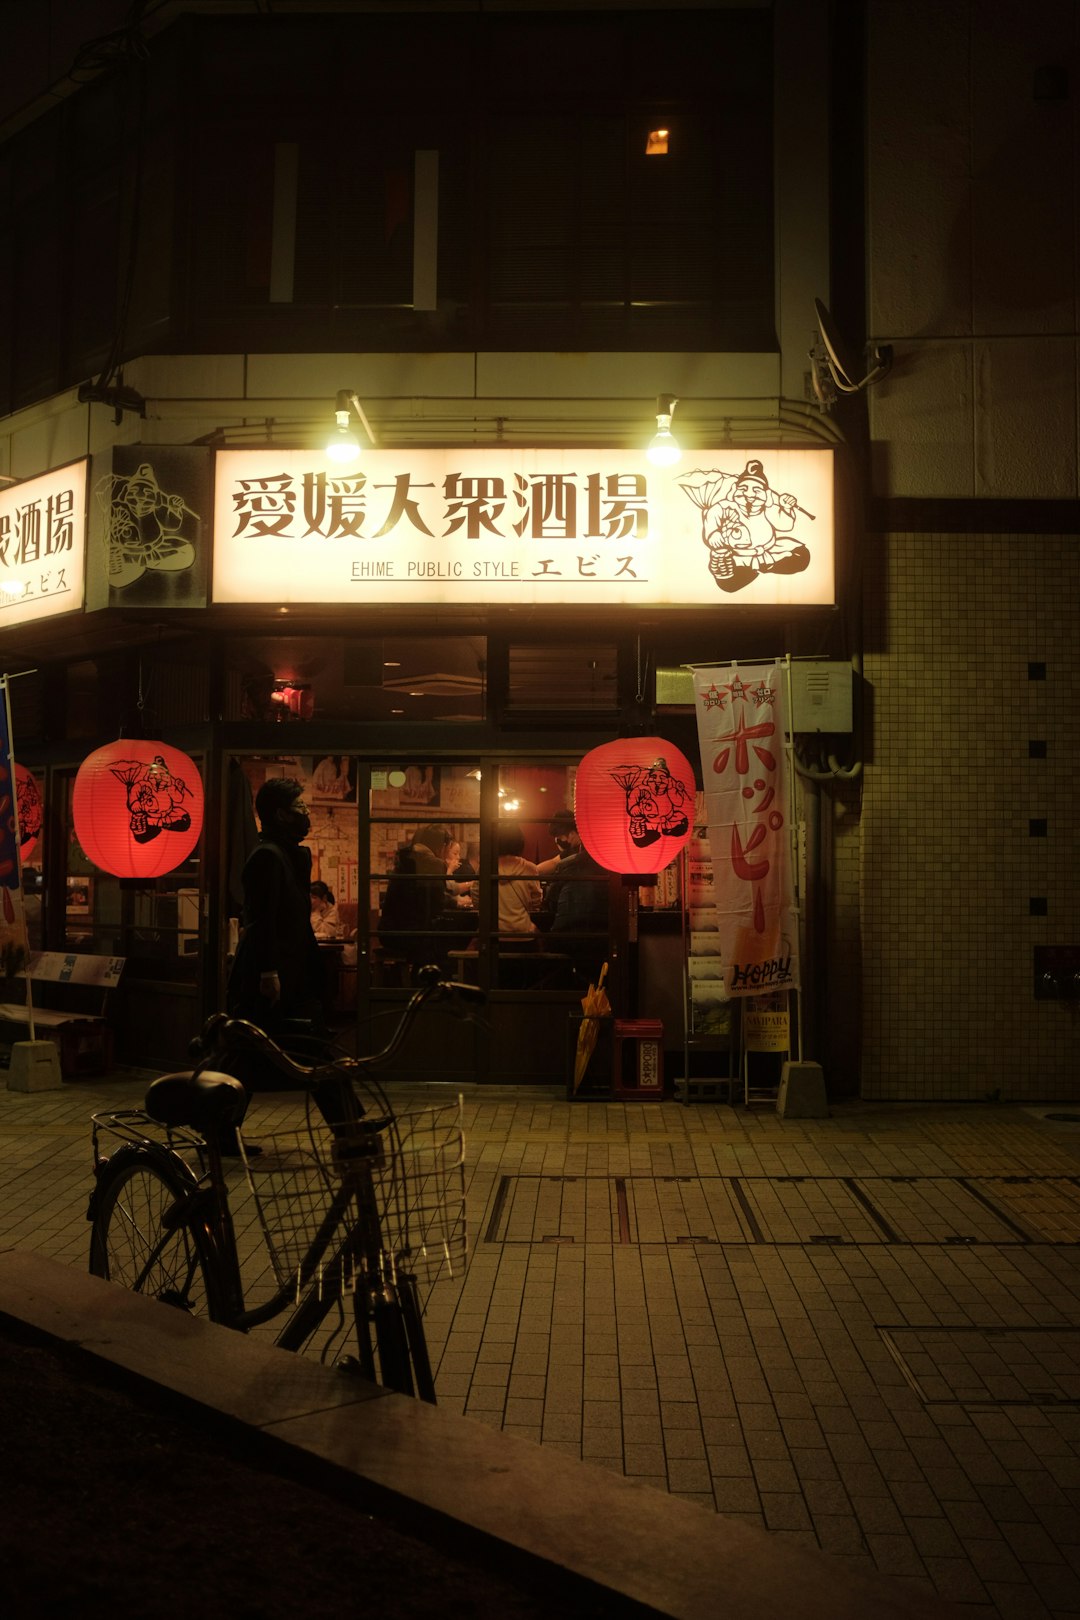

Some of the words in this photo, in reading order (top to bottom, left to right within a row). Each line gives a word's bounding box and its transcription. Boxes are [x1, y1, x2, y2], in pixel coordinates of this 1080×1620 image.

[231, 472, 648, 539] 愛媛大衆酒場
[351, 561, 394, 577] EHIME
[408, 561, 462, 577] PUBLIC
[473, 561, 520, 577] STYLE
[531, 553, 637, 578] エビス
[21, 568, 66, 598] エビス
[711, 704, 783, 934] ホッピー
